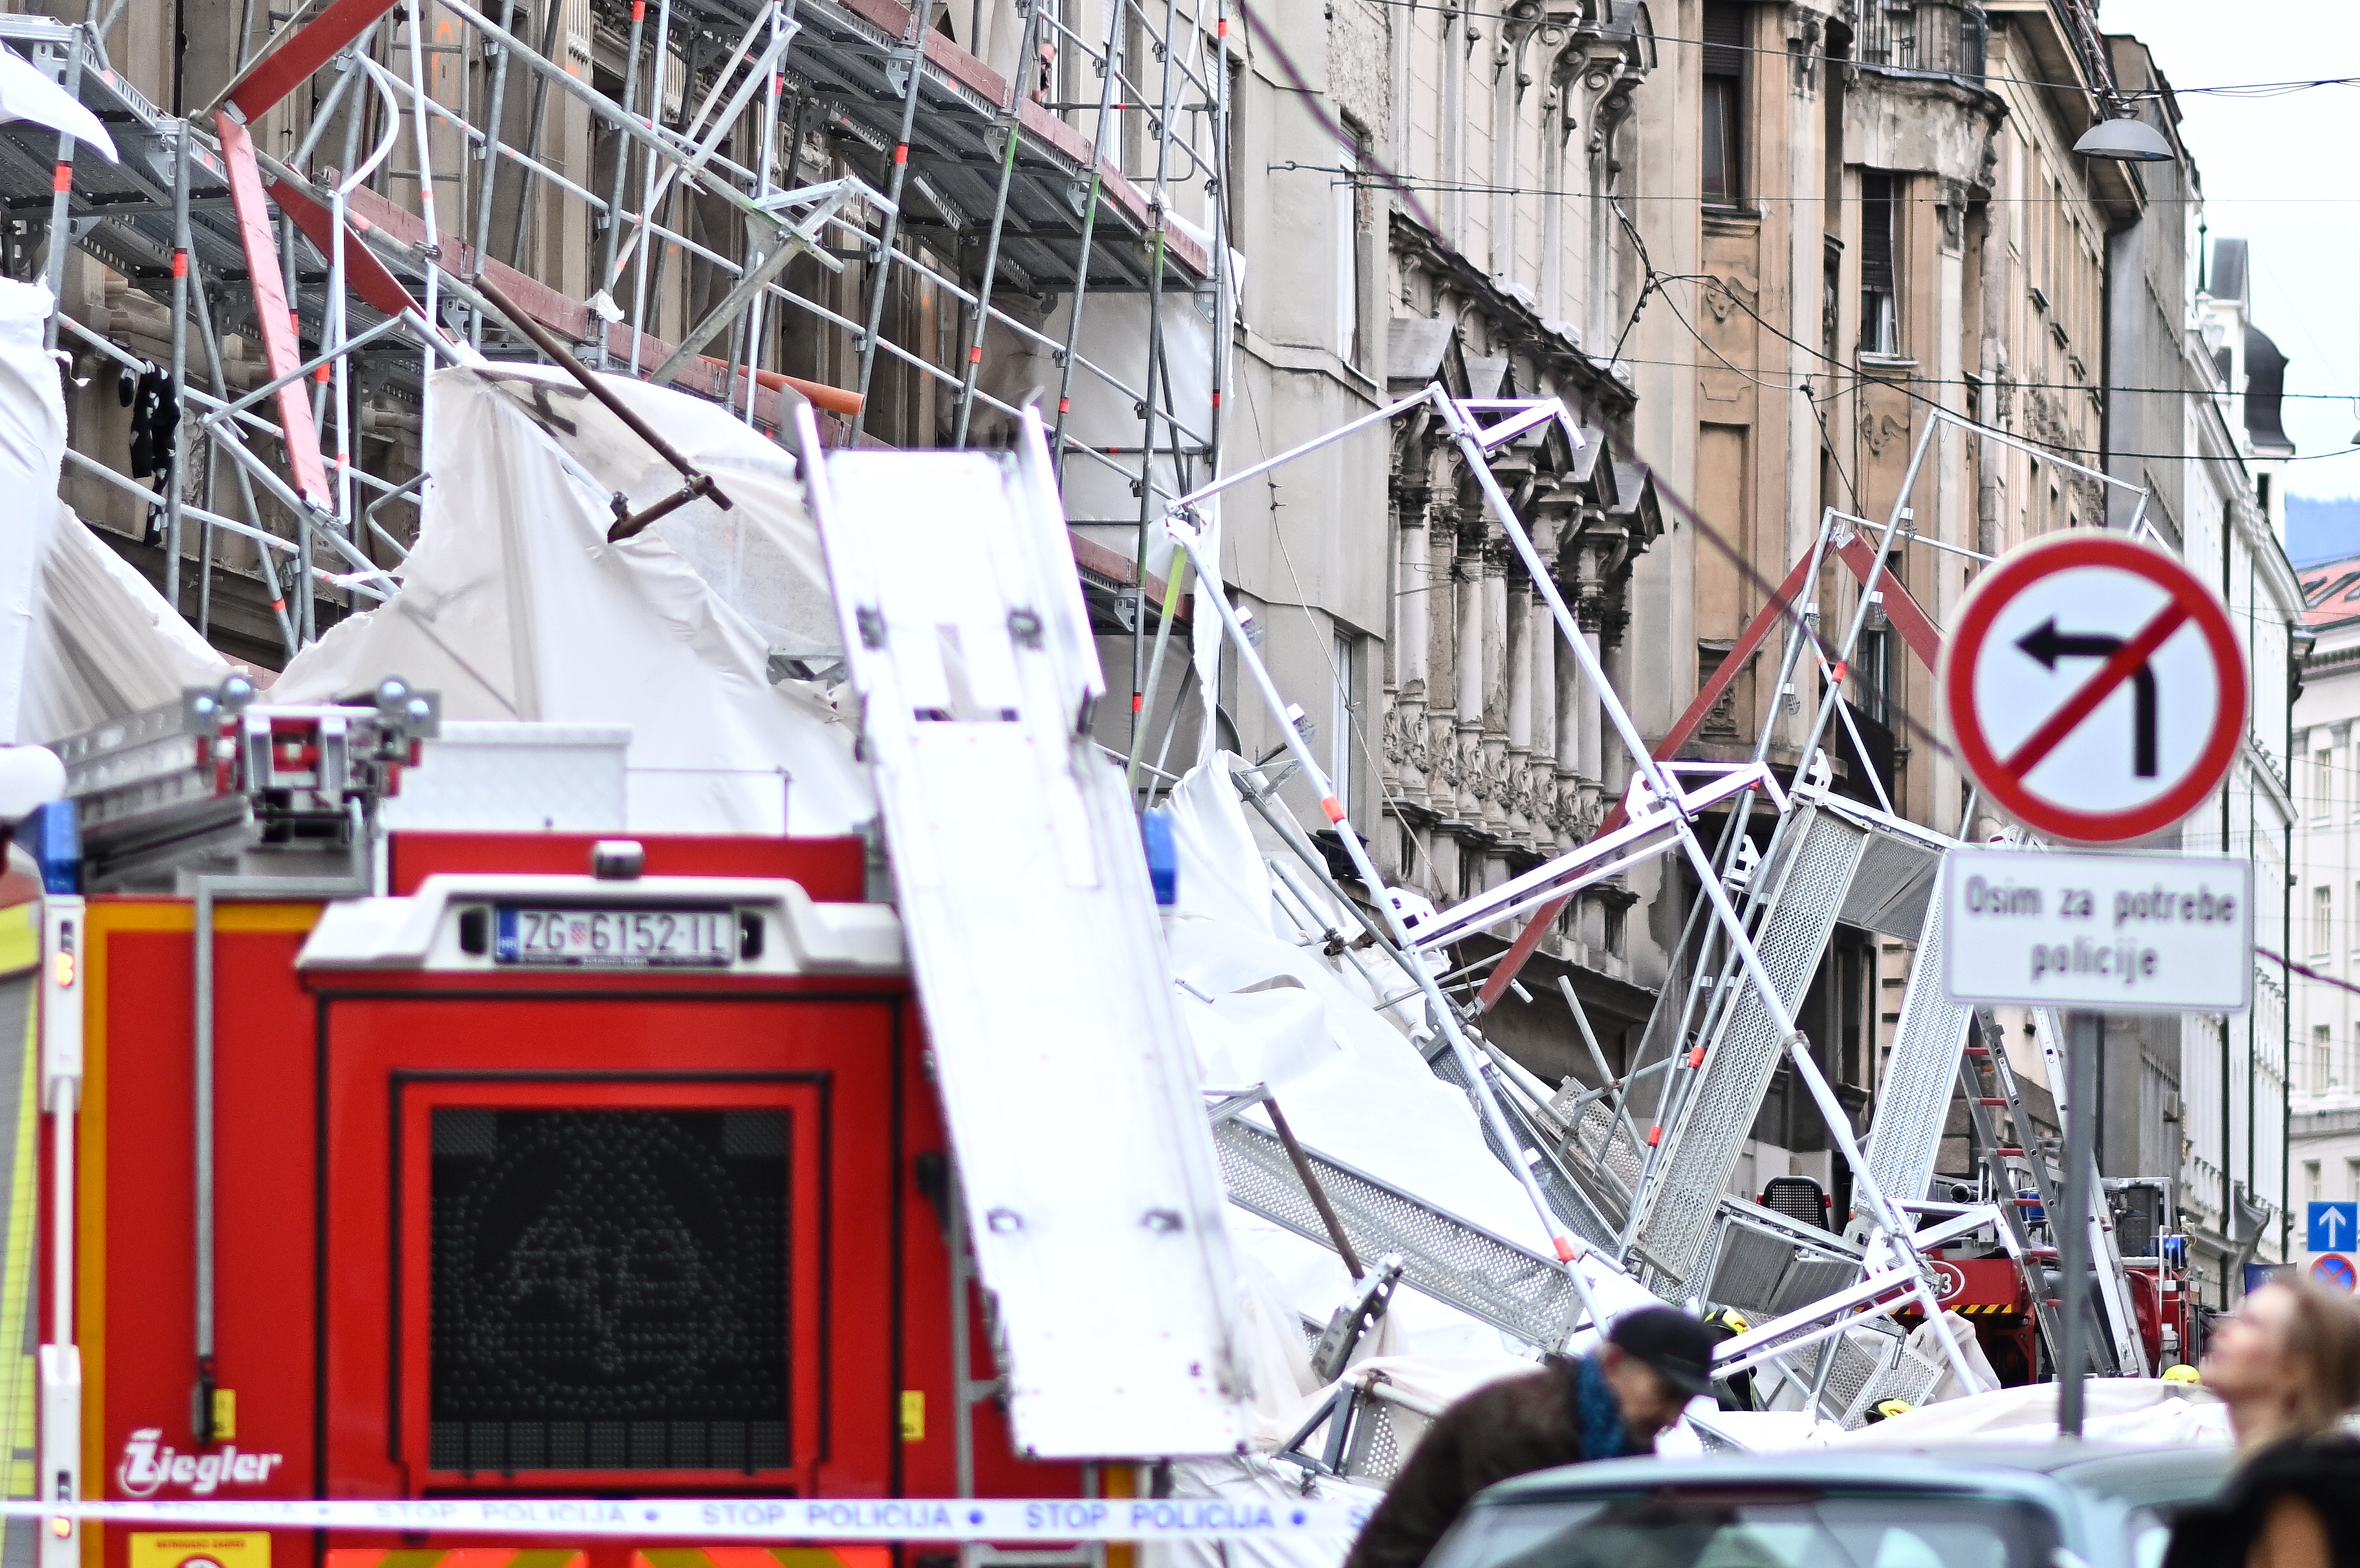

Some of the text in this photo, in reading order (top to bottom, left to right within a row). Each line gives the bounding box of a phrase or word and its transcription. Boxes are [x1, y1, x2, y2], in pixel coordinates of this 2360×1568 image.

[1965, 875, 2237, 929] Osim za potrebe
[523, 913, 565, 950] ZG
[2031, 938, 2159, 984] policije
[122, 1428, 283, 1494] Ziegler
[376, 1502, 457, 1519] STOP
[482, 1502, 628, 1524] POLICIJA
[703, 1503, 785, 1526] STOP
[808, 1503, 952, 1529] POLICIJA
[1026, 1503, 1108, 1529] STOP
[1130, 1503, 1275, 1529] POLICIJA
